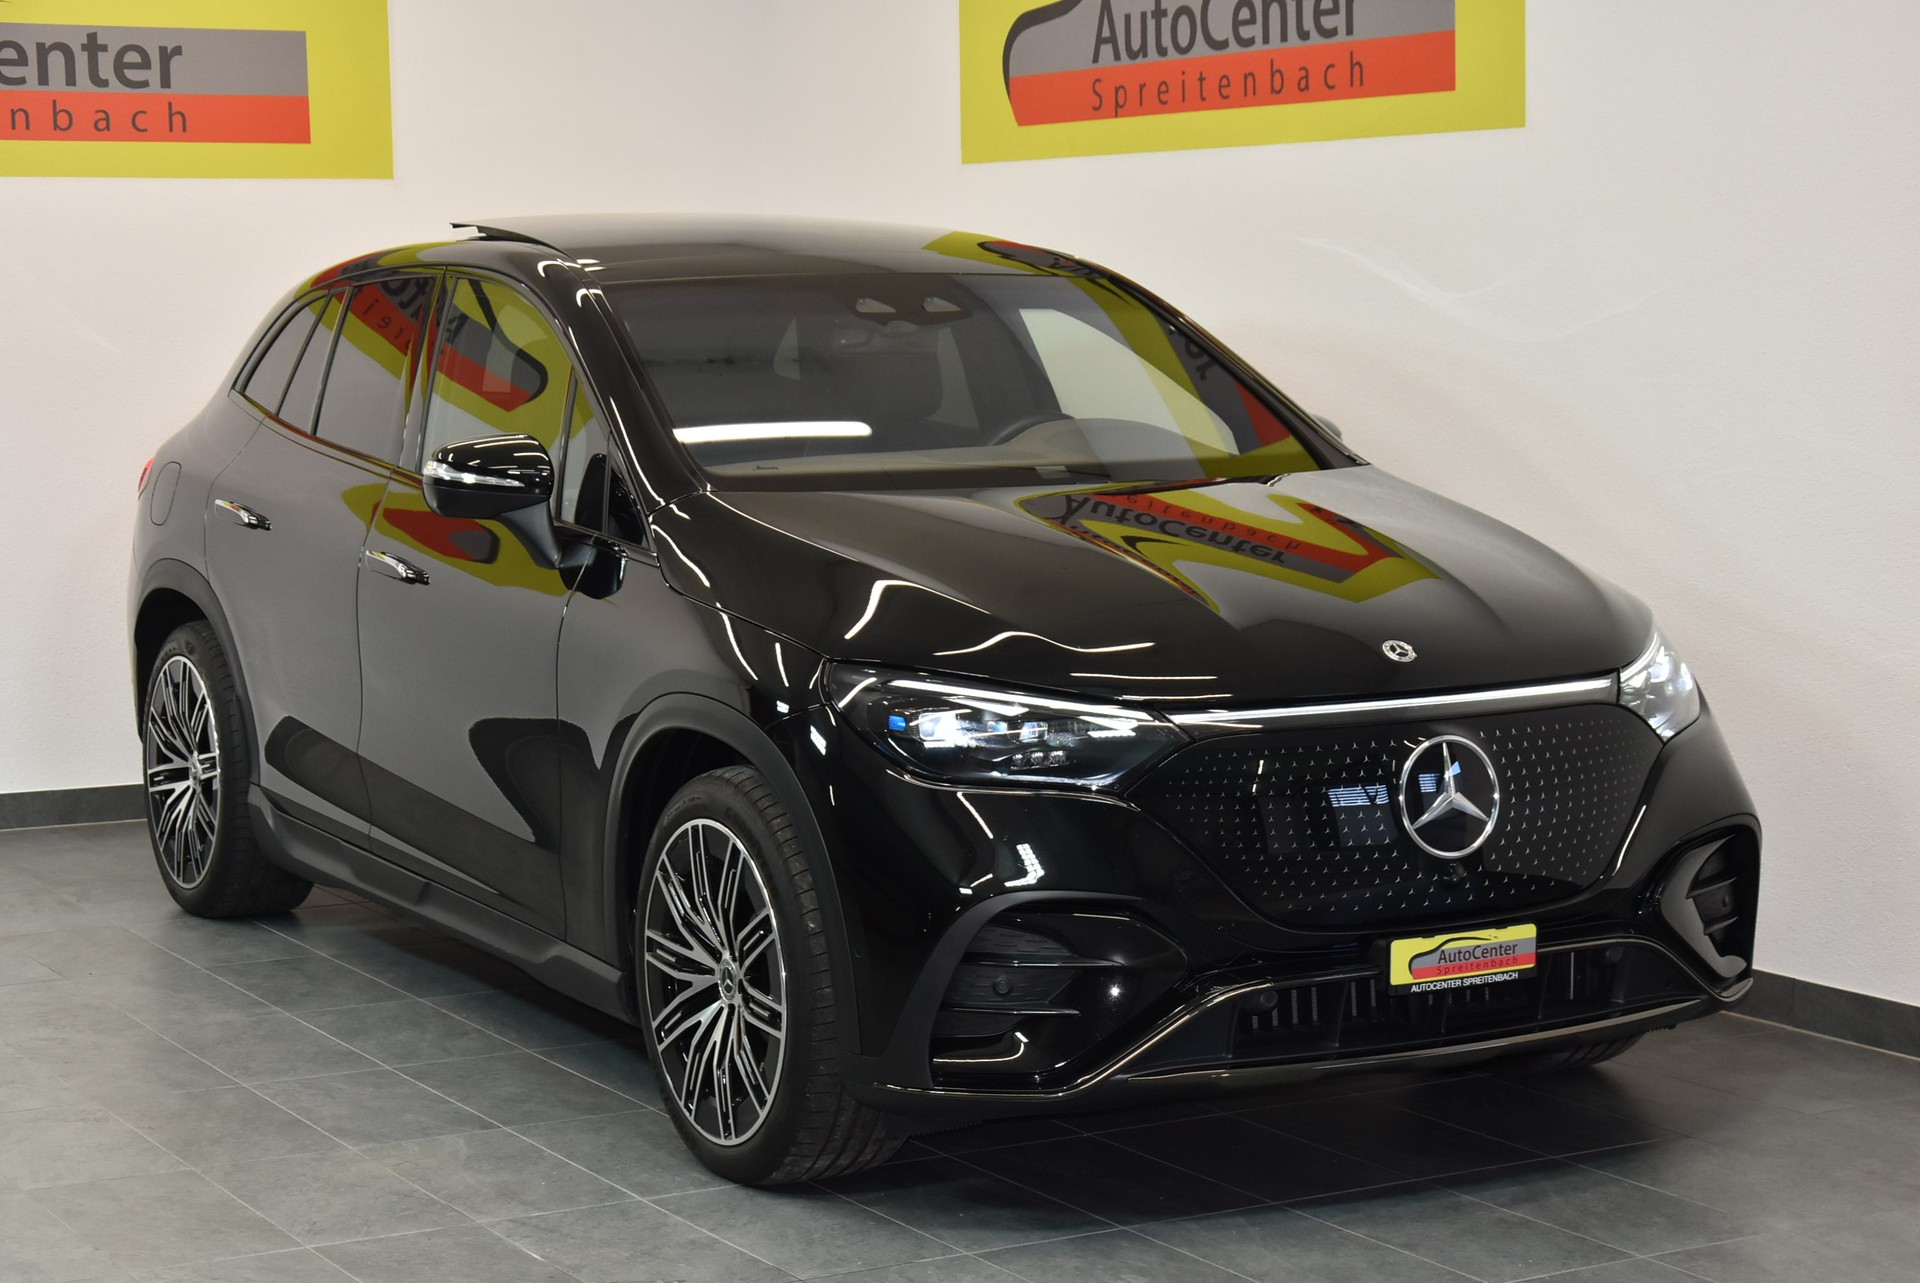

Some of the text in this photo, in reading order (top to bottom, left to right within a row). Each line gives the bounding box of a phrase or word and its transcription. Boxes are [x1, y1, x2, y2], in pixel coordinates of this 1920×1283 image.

[1092, 0, 1355, 64] AutoCenter
[1092, 51, 1364, 118] Spreitenbach
[10, 100, 188, 133] nbach
[1437, 944, 1518, 964] AutoCenter
[1437, 956, 1518, 975] Spreitenbach
[1410, 971, 1519, 993] AUTOCENTER SPREITENBACH
